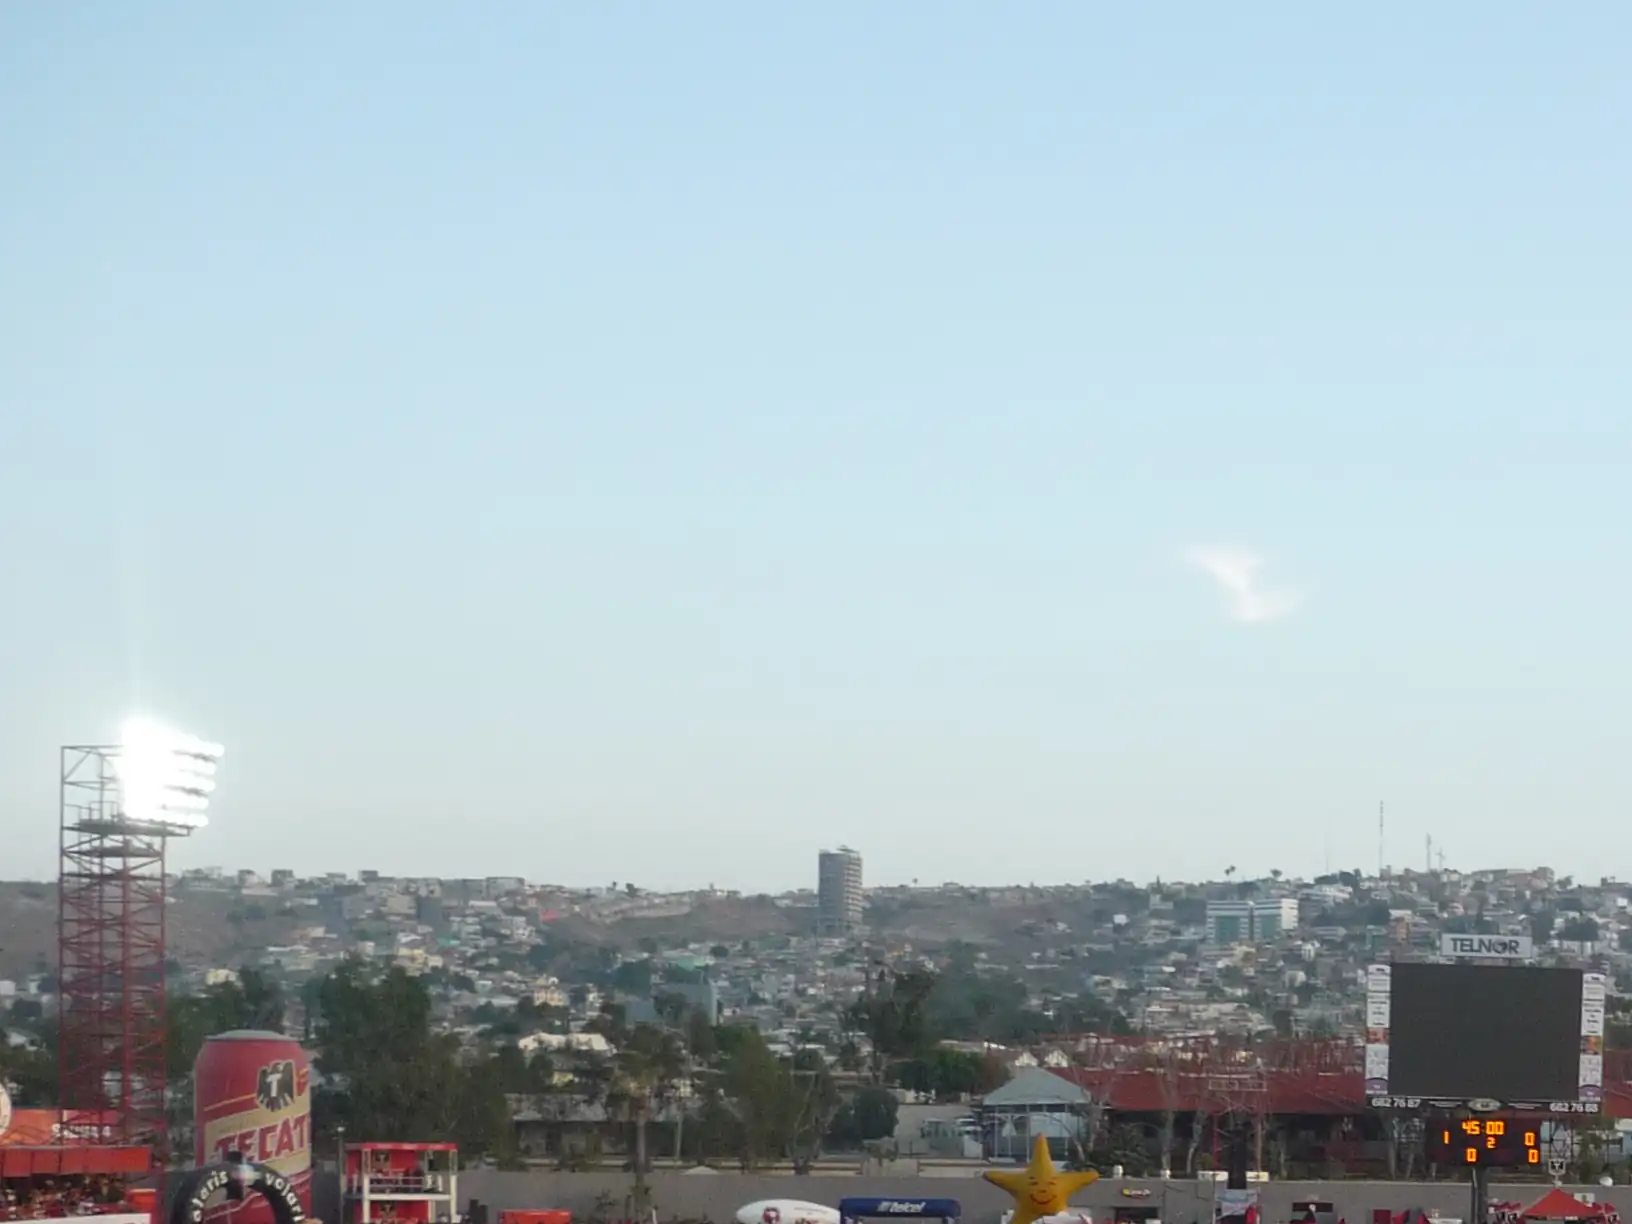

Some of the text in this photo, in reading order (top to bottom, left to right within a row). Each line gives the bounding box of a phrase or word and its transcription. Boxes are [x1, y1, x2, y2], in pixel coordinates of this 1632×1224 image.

[1451, 938, 1520, 954] TELNOR
[1461, 1120, 1505, 1135] 45:00
[1443, 1130, 1450, 1145] 1
[1486, 1137, 1496, 1149] 2
[1525, 1131, 1536, 1146] 0
[1466, 1148, 1539, 1164] 0 0
